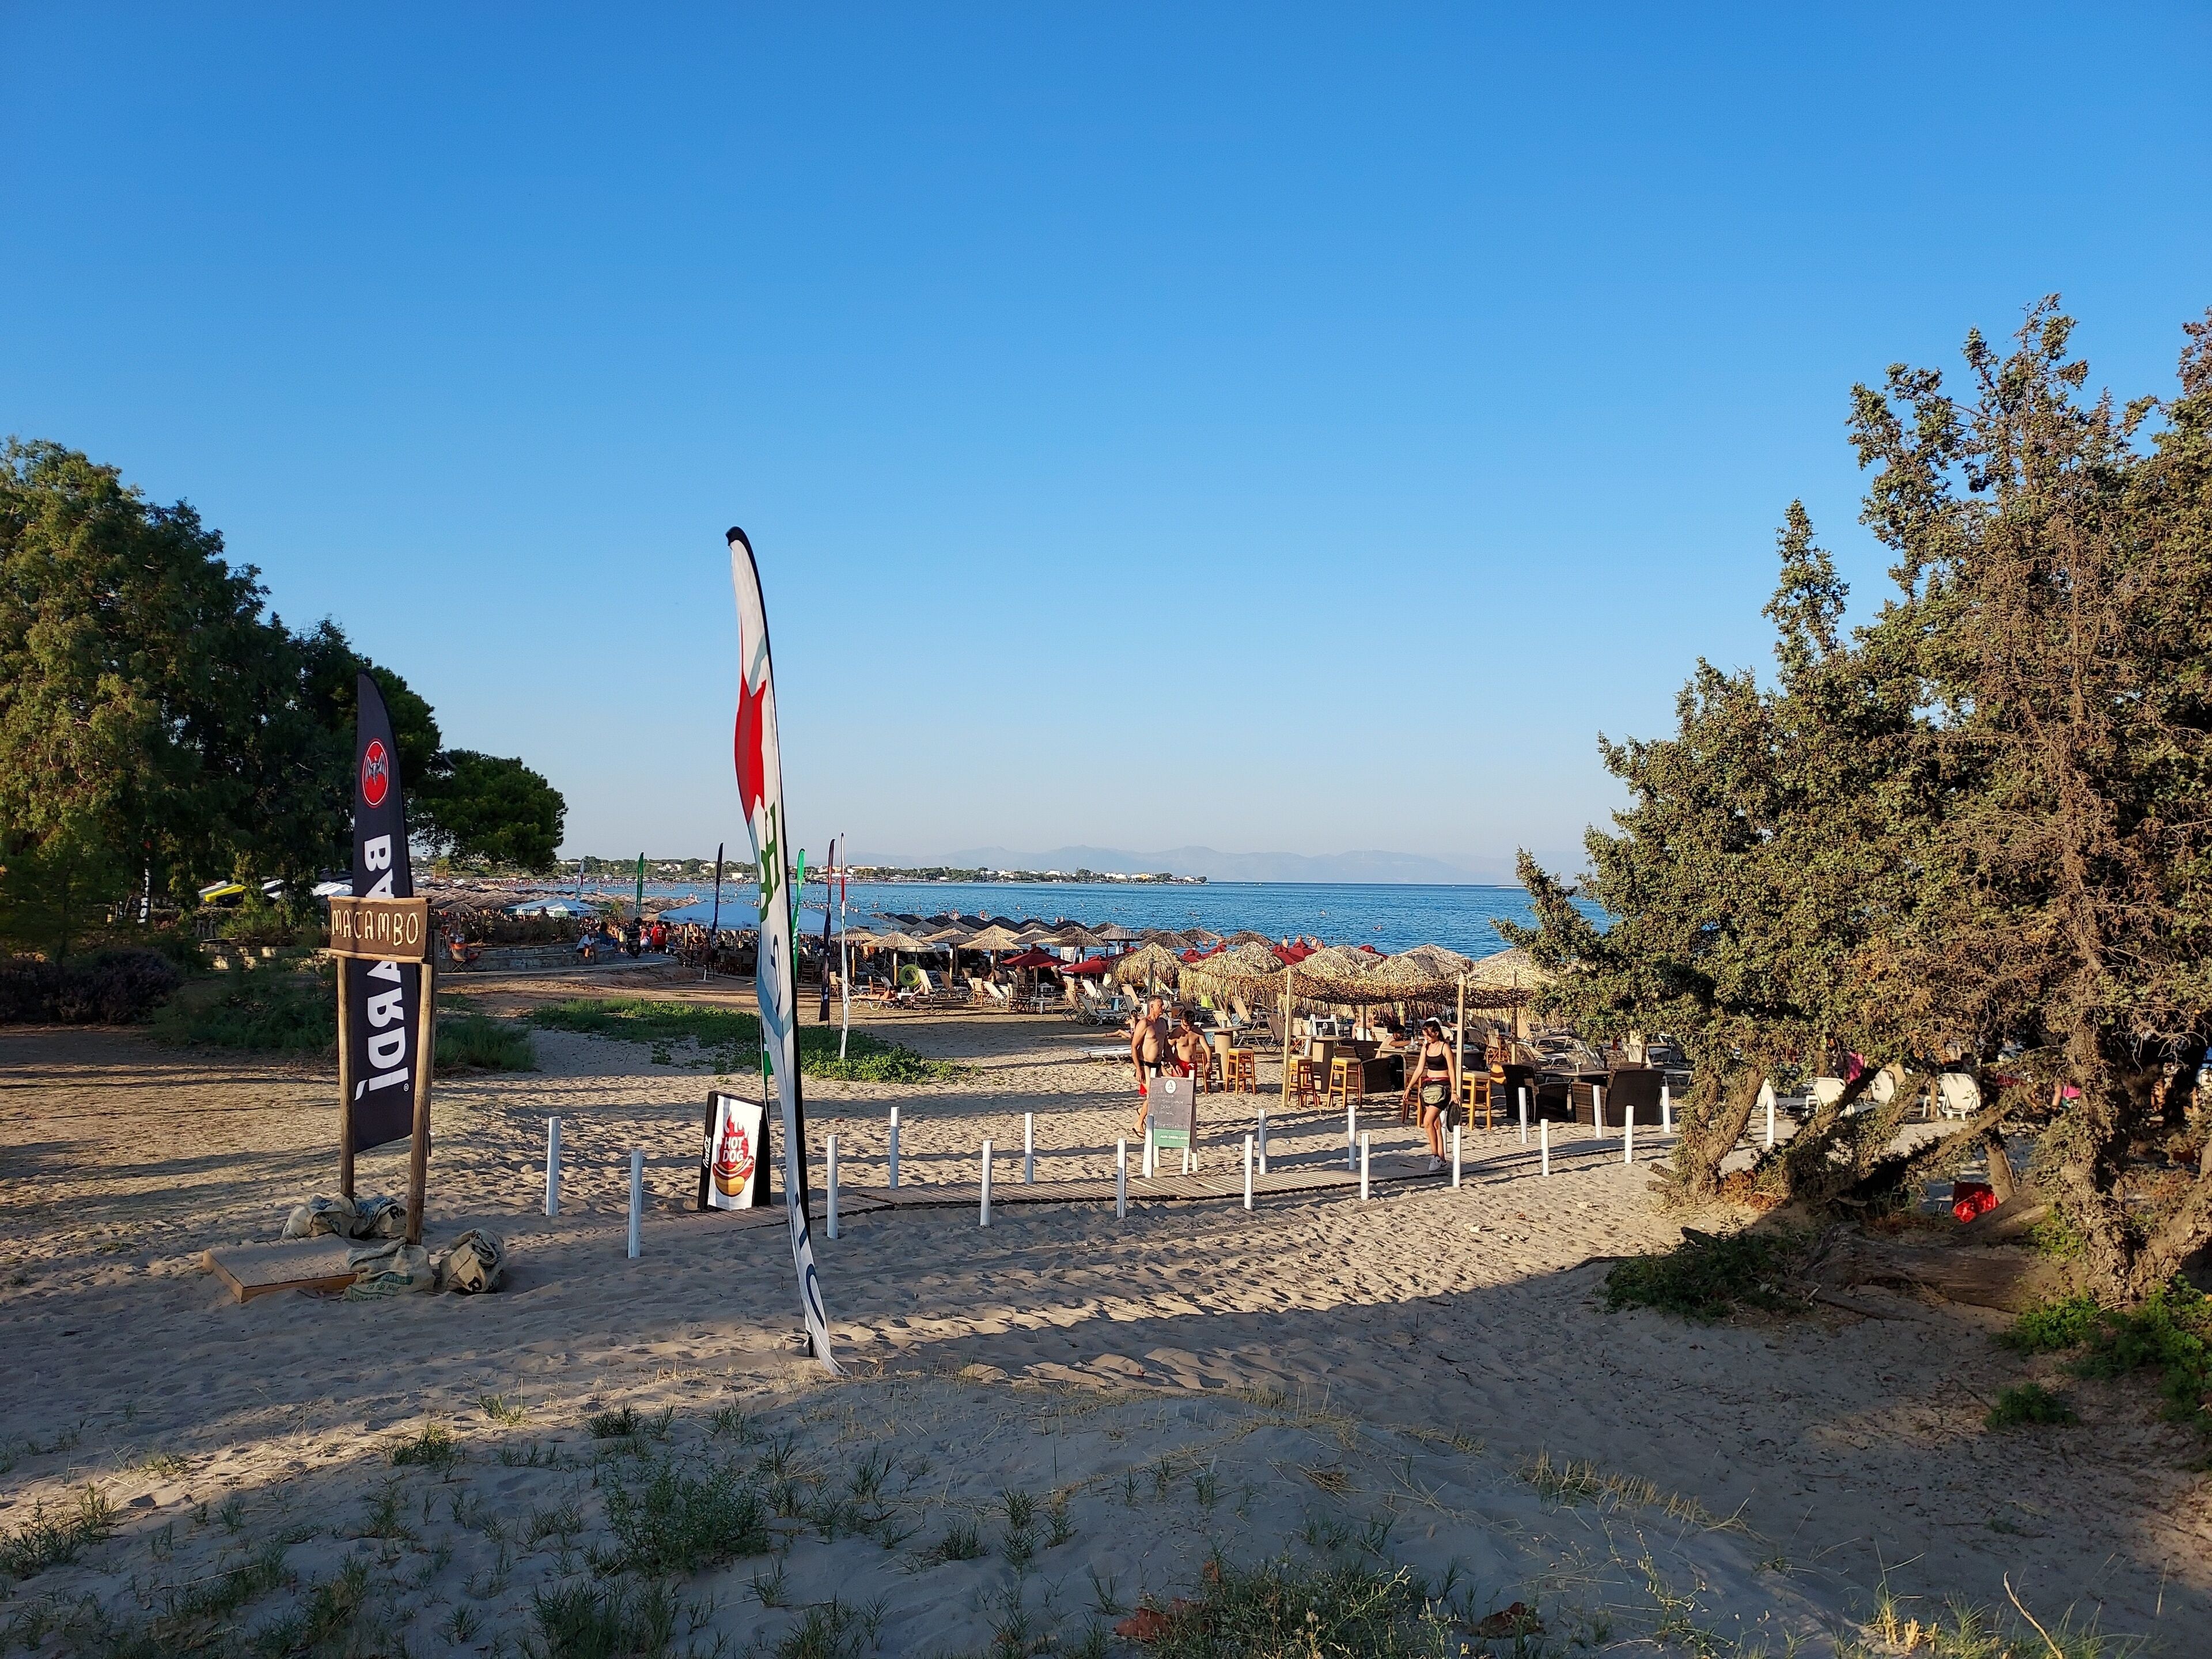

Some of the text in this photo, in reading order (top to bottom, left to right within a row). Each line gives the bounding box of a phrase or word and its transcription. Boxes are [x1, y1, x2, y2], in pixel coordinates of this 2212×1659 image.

[332, 909, 419, 946] MACAMBO
[724, 1136, 744, 1150] HOT
[722, 1149, 744, 1162] DOG
